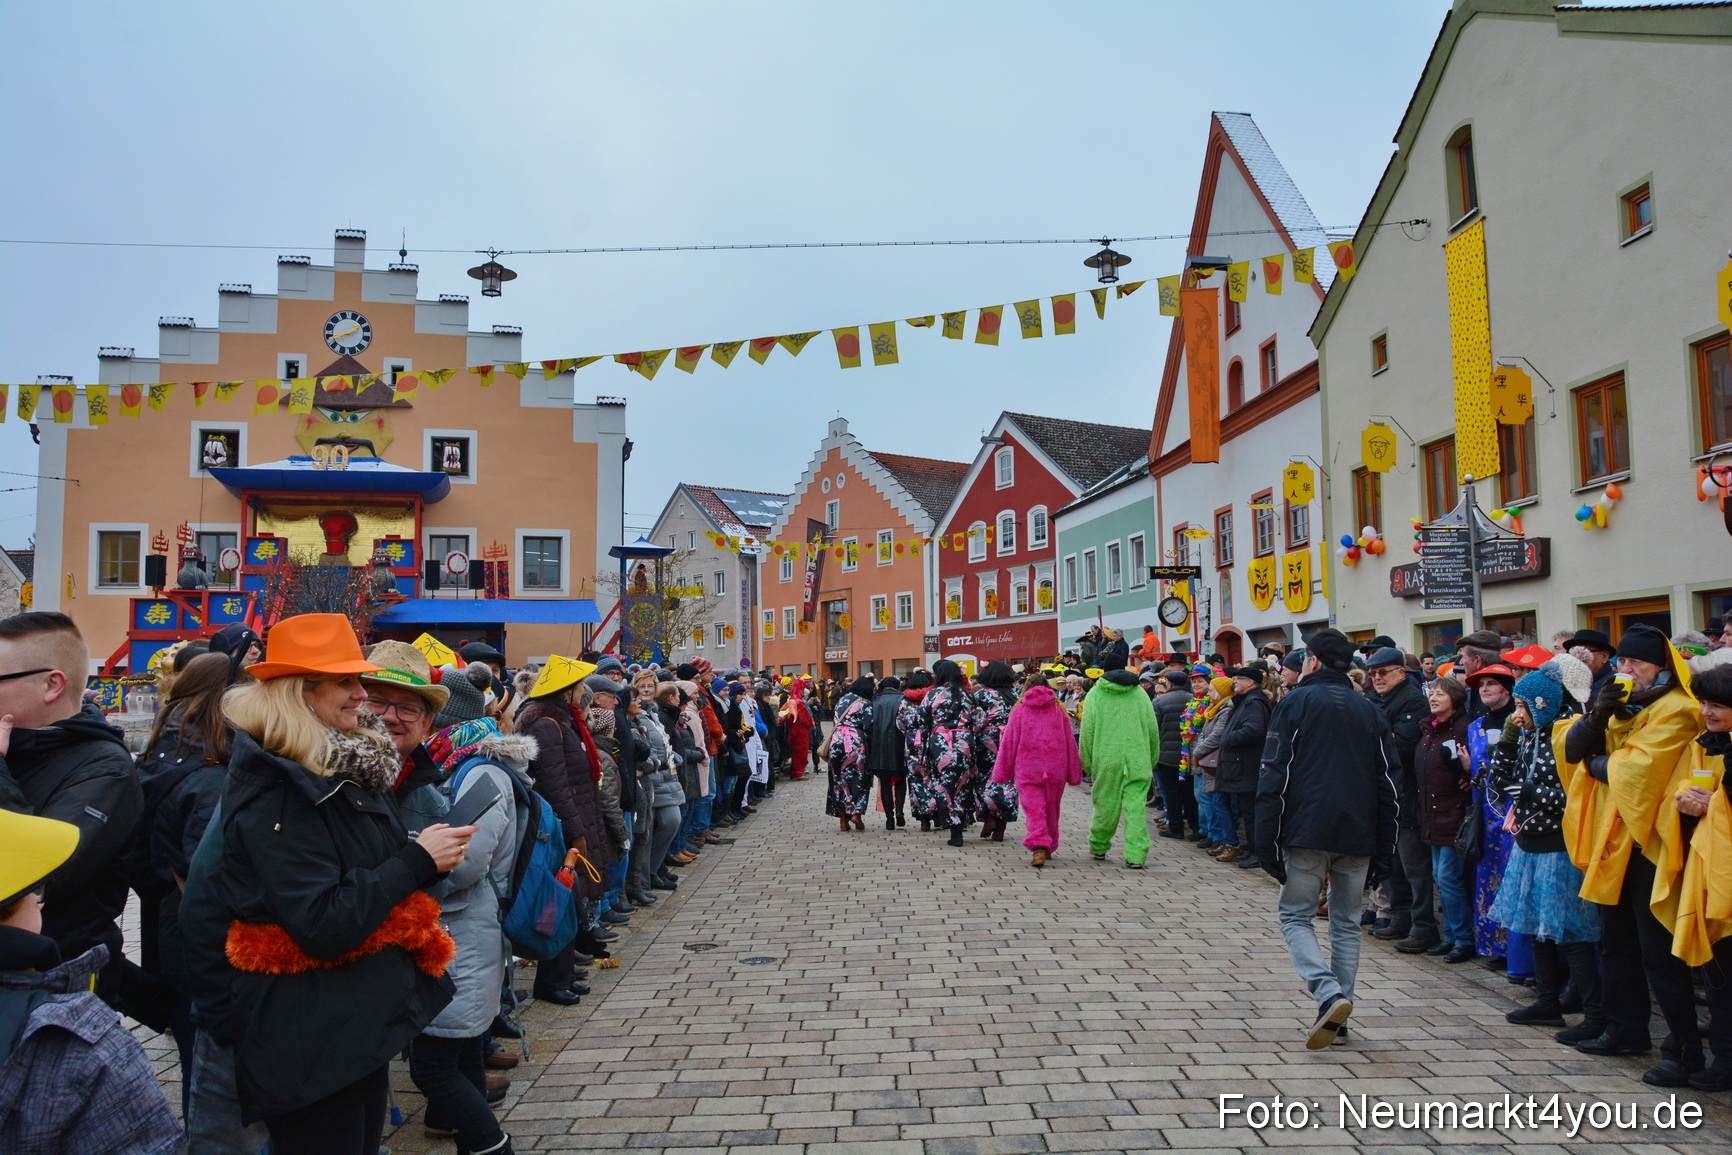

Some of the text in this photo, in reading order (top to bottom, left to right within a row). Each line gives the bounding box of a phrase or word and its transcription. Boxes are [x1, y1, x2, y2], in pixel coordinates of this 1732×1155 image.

[1496, 405, 1506, 417] 人
[311, 445, 349, 470] 90
[1290, 490, 1298, 498] 人
[924, 635, 938, 644] CAFÉ
[824, 650, 848, 660] GÖTZ
[377, 670, 412, 683] Wittmann
